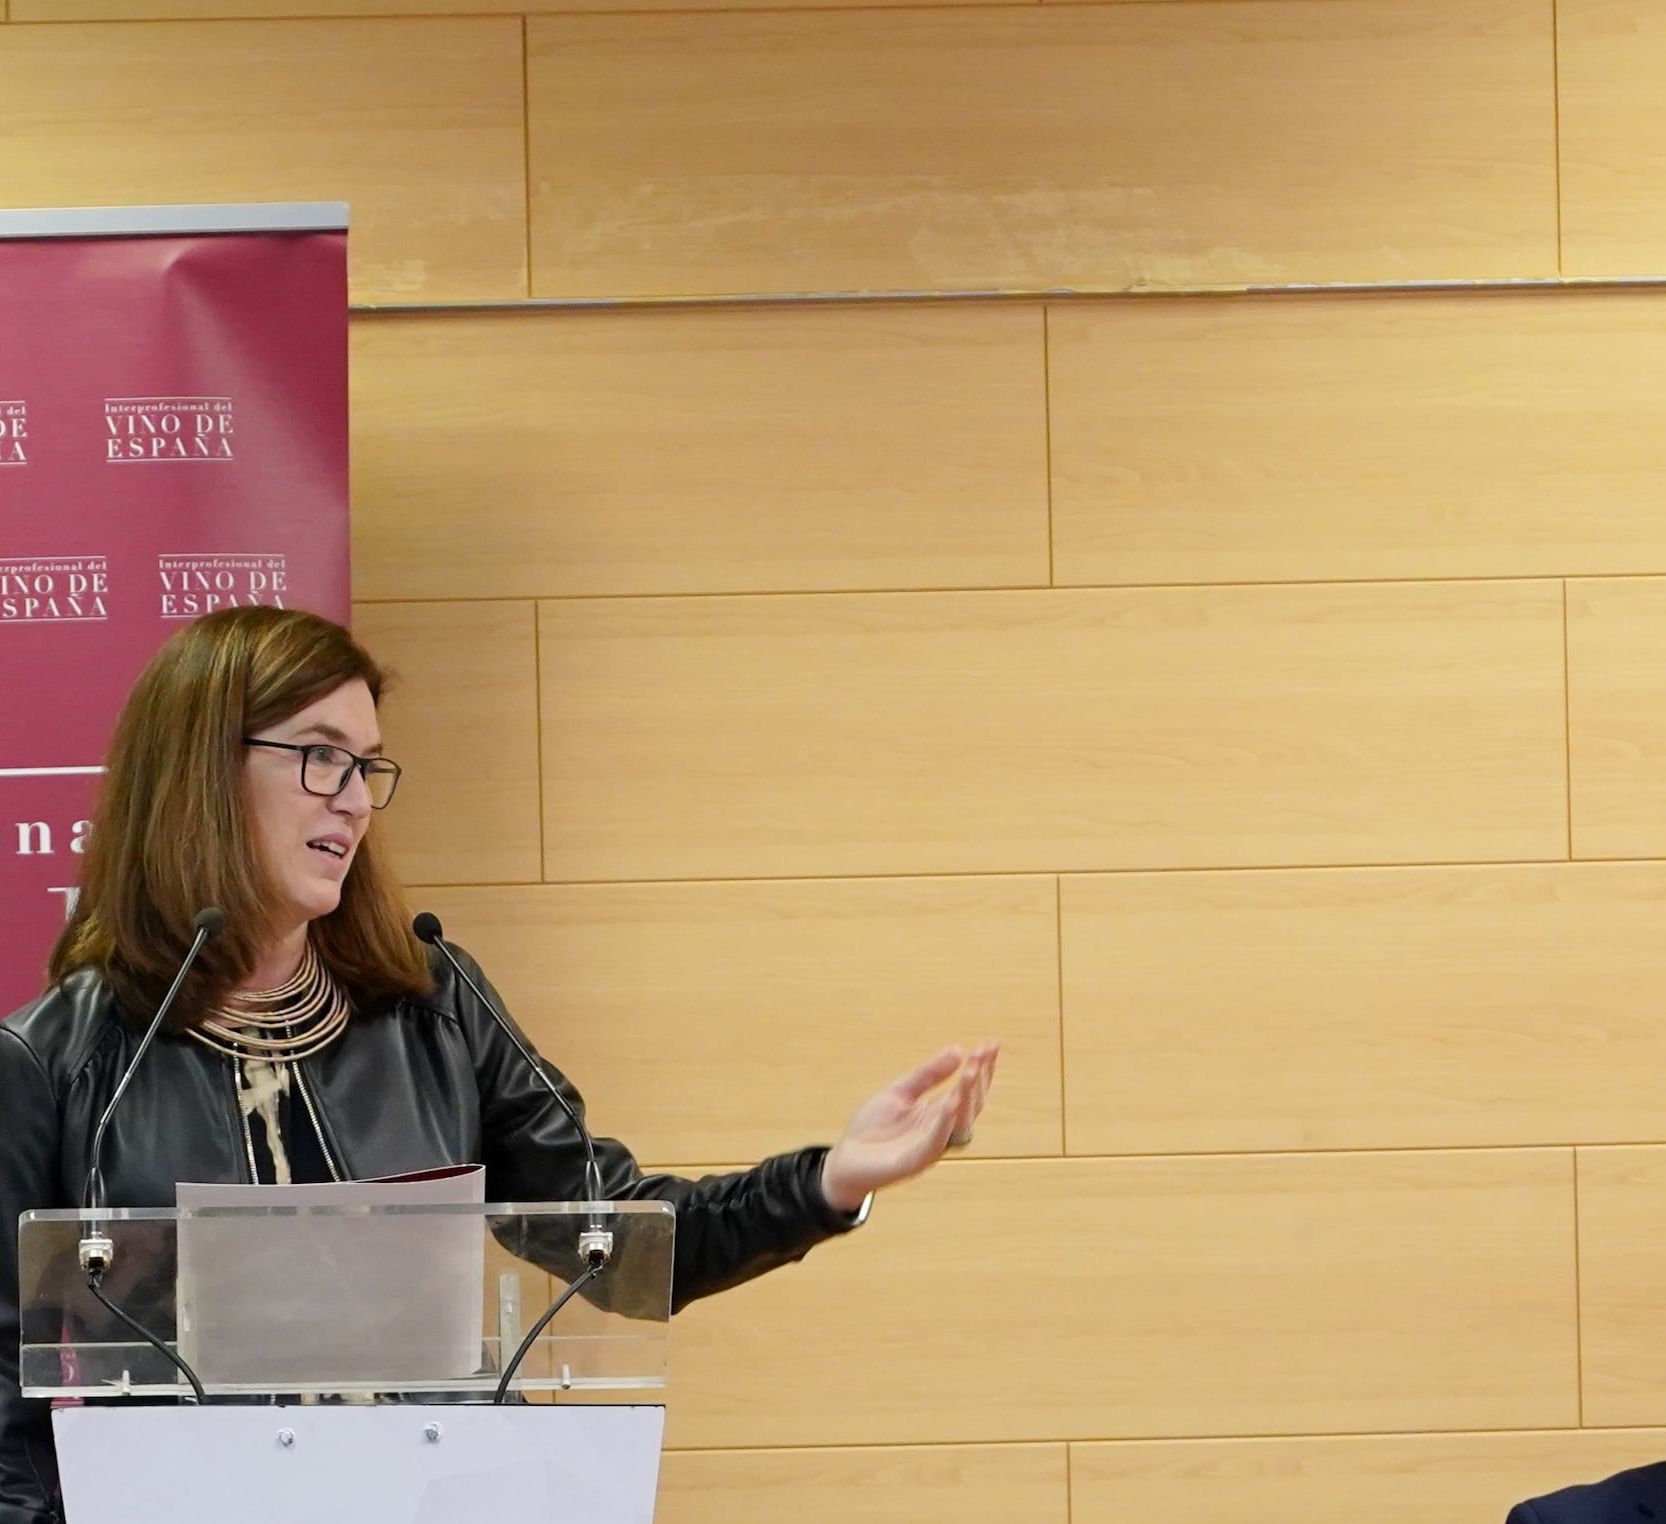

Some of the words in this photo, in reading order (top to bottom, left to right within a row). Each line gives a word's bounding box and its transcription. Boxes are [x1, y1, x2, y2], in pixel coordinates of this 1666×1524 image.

[6, 406, 27, 416] del
[105, 401, 208, 414] Interprofesional
[213, 402, 234, 411] del
[106, 413, 180, 435] VINO
[195, 414, 235, 434] DE
[108, 435, 235, 458] ESPAÑA
[87, 561, 108, 571] del
[159, 558, 261, 569] Interprofesional
[266, 559, 287, 568] del
[69, 574, 108, 594] DE
[160, 570, 234, 590] VINO
[249, 572, 288, 591] DE
